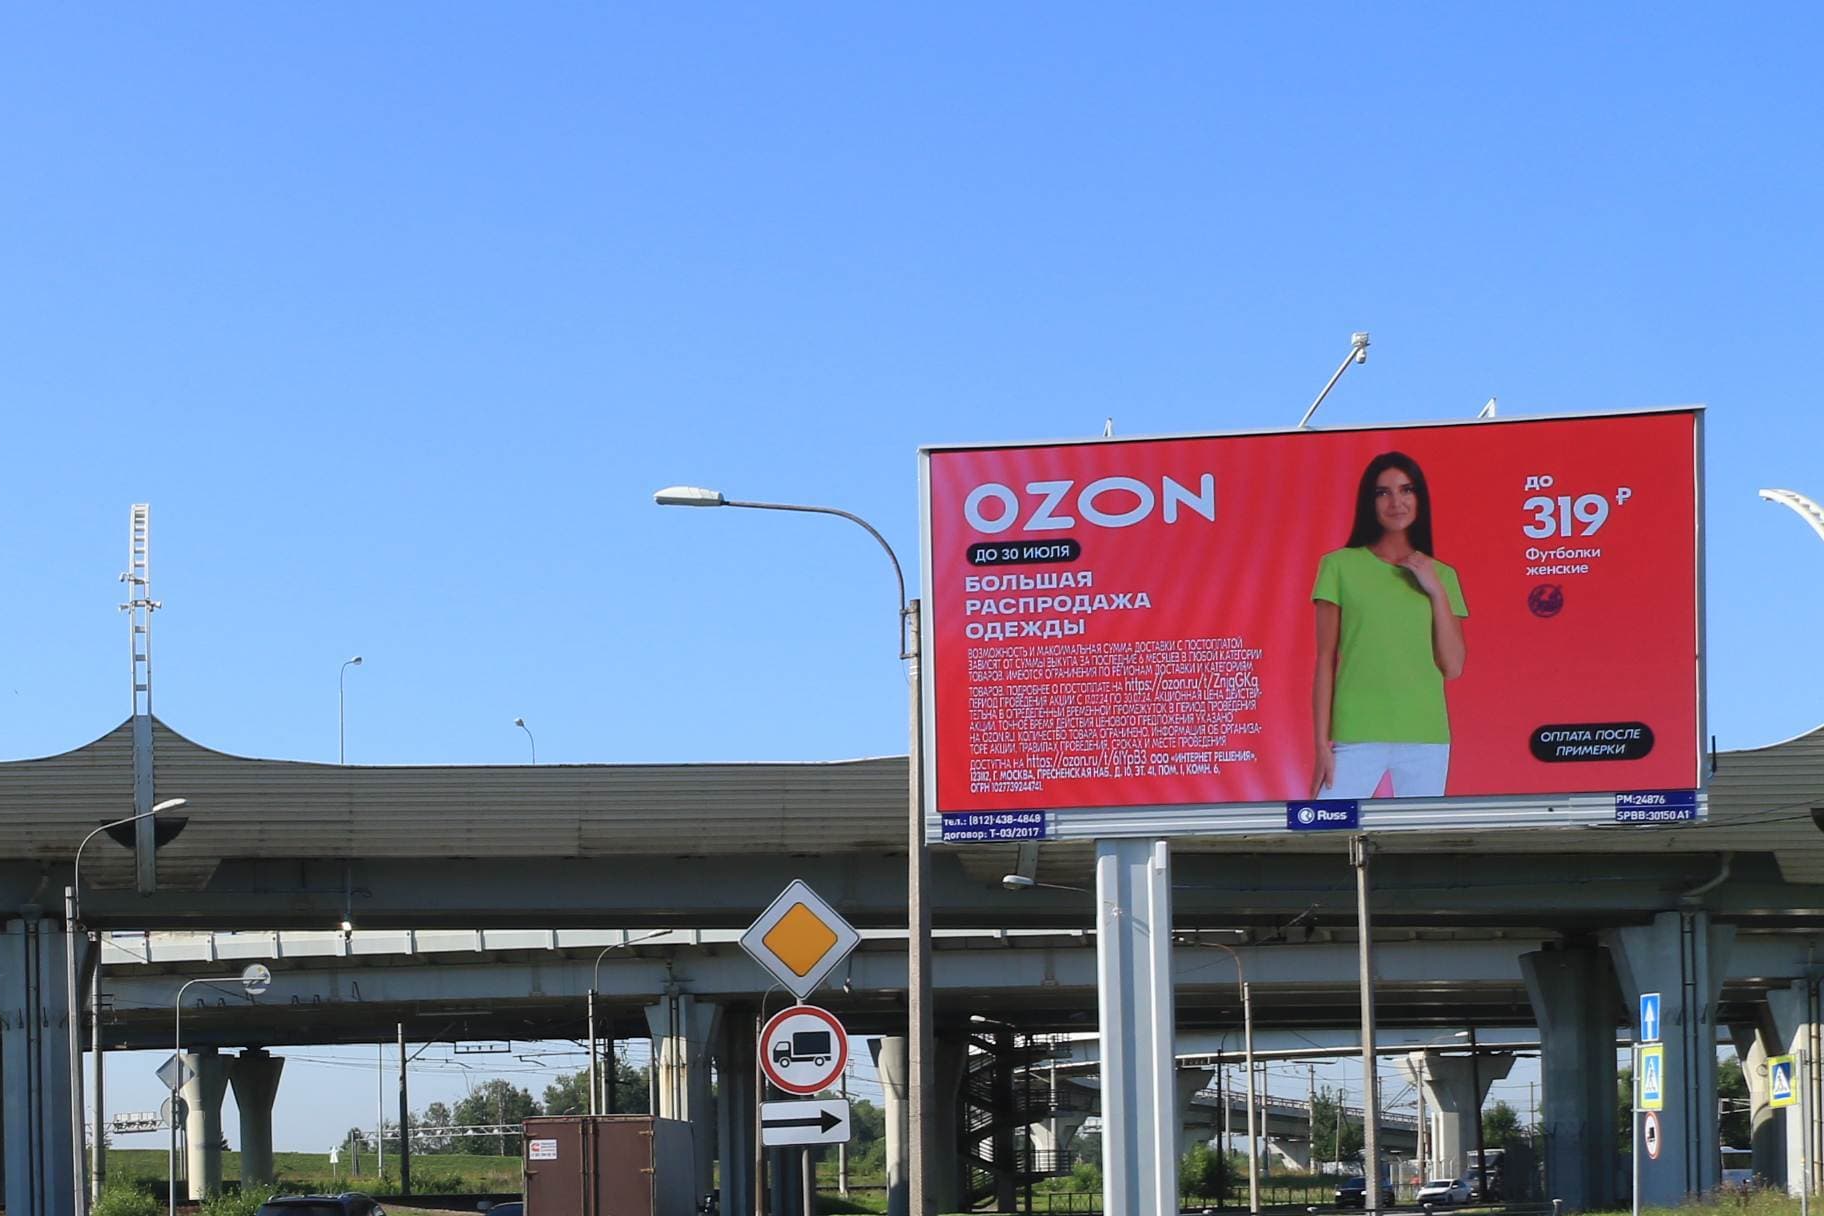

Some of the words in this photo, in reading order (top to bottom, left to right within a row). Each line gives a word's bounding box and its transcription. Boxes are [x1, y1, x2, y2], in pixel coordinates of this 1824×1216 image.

[964, 473, 1215, 534] OZON
[1522, 493, 1609, 539] 319
[975, 549, 997, 563] ДО
[1002, 548, 1019, 560] 30
[1023, 545, 1070, 559] ИЮЛЯ
[1525, 547, 1601, 562] Футболки
[1526, 564, 1589, 576] женские
[965, 571, 1093, 592] БОЛЬШАЯ
[965, 592, 1152, 616] РАСПРОДАЖА
[965, 619, 1085, 640] ОДЕЖДЫ
[1541, 729, 1592, 743] ОПЛАТА
[1595, 727, 1641, 741] ПОСЛЕ
[1556, 744, 1626, 757] ПРИМЕРКИ
[1317, 810, 1347, 821] Russ
[944, 830, 987, 841] договор:
